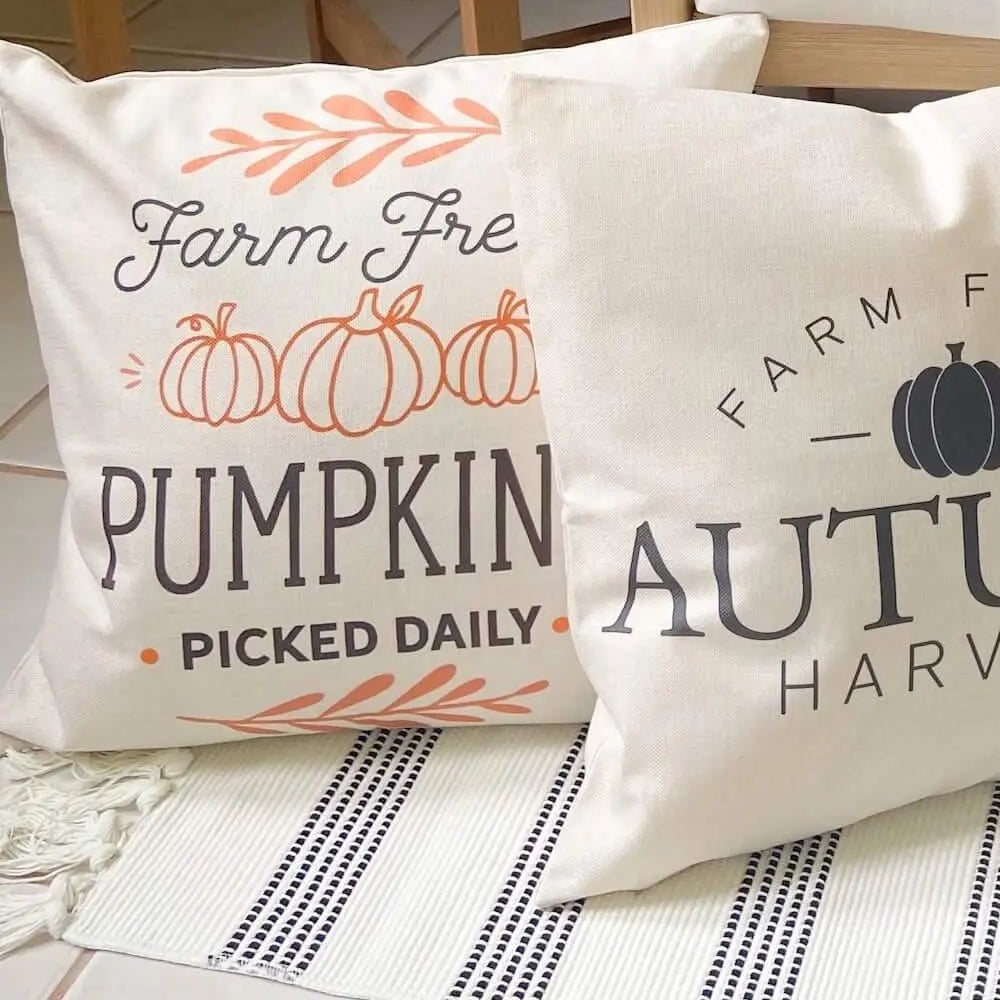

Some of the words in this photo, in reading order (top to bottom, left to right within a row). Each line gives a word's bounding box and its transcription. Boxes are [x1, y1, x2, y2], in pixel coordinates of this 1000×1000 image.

[113, 197, 349, 292] Farm
[361, 187, 519, 284] Fre
[715, 287, 903, 430] FARM
[100, 442, 553, 596] PUMPKIN
[180, 620, 379, 671] PICKED
[395, 604, 543, 654] DAILY
